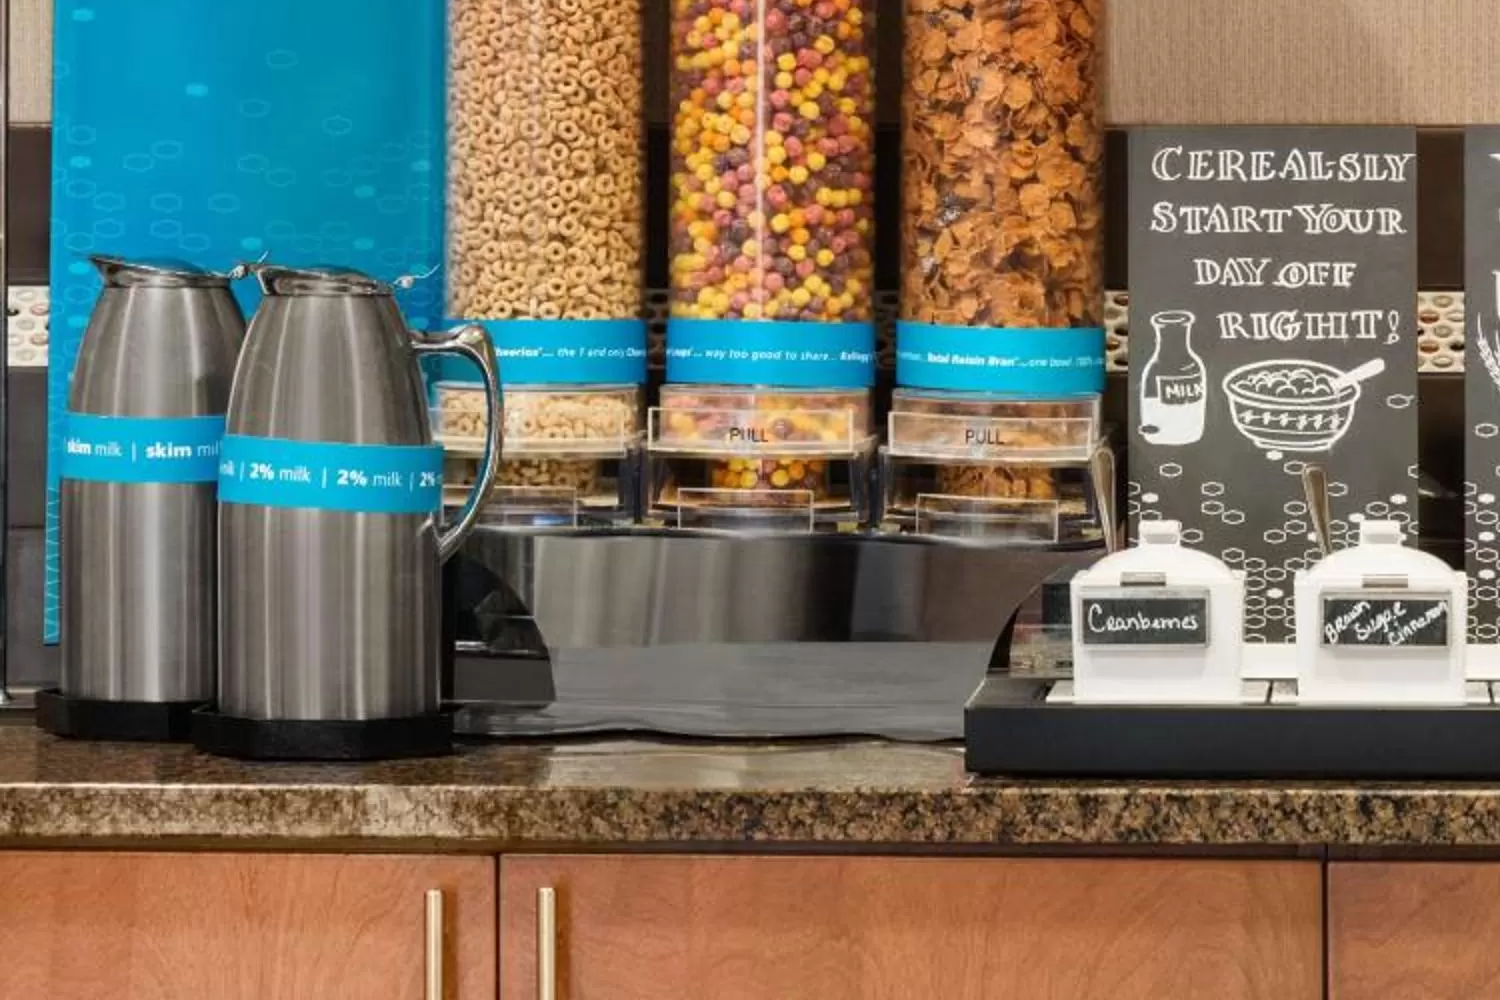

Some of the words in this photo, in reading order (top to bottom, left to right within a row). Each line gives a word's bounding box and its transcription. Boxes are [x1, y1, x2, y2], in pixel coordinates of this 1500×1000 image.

[1151, 201, 1292, 234] START
[1293, 203, 1408, 235] YOUR
[1192, 258, 1272, 286] DAY
[1272, 262, 1357, 288] OFF
[1216, 309, 1401, 345] RIGHT!
[751, 350, 781, 362] good
[729, 427, 769, 442] PULL
[965, 429, 1005, 445] PULL
[145, 441, 193, 459] skim
[250, 462, 274, 481] 2%
[279, 465, 312, 482] milk
[336, 469, 367, 487] 2%
[372, 471, 403, 487] milk
